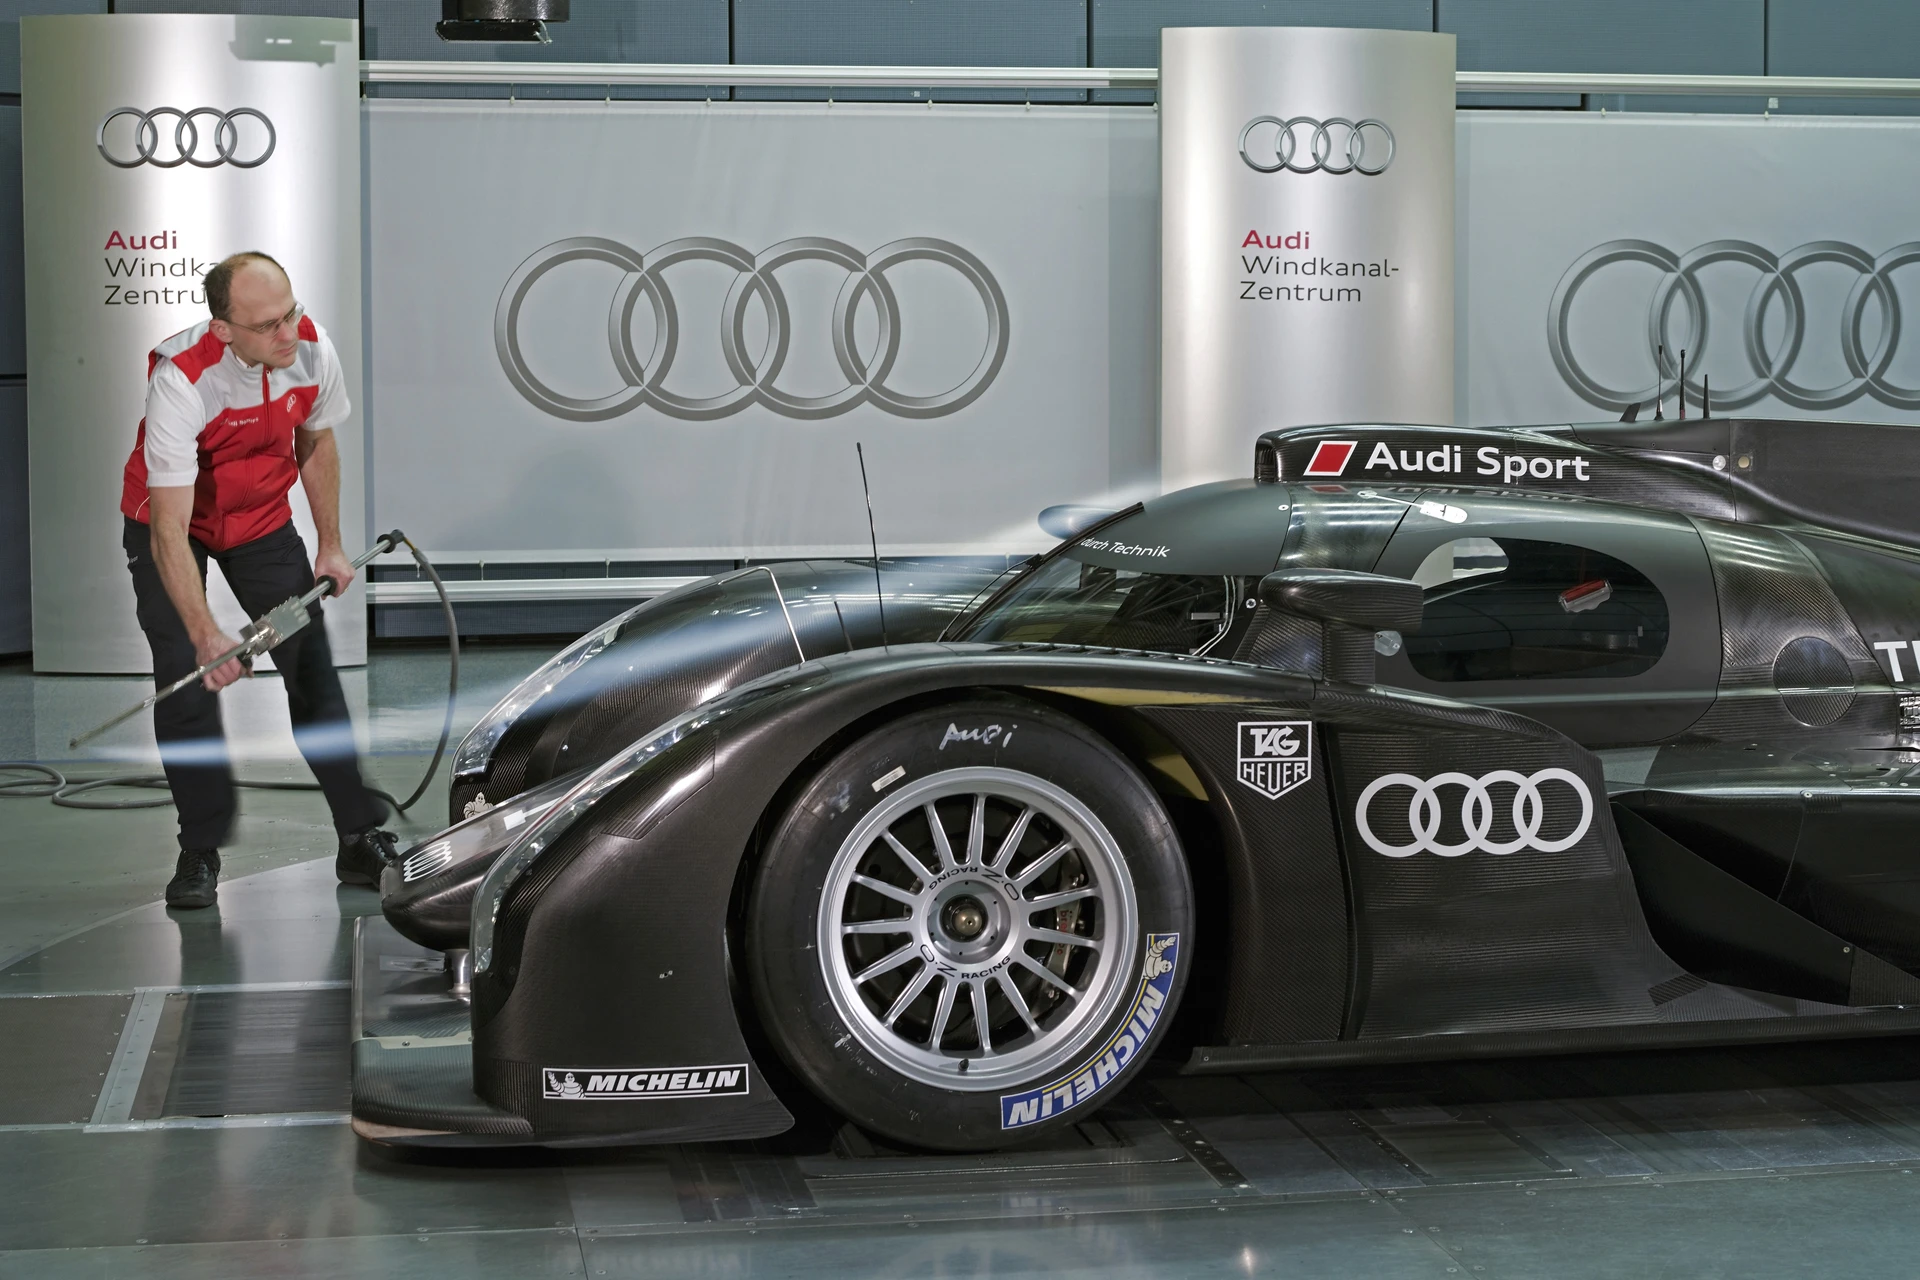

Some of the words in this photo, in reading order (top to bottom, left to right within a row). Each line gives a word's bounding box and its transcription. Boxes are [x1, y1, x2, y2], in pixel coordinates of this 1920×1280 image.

[104, 230, 177, 250] Audi
[1241, 229, 1310, 250] Audi
[1241, 255, 1399, 278] Windkanal-
[1239, 281, 1362, 302] Zentrum
[1364, 441, 1462, 473] Audi
[1476, 446, 1590, 484] Sport
[1109, 542, 1171, 558] Technik
[1873, 640, 1920, 683] T
[1250, 725, 1301, 757] TAG
[1243, 762, 1306, 794] HEUER
[929, 866, 979, 891] RACING
[960, 955, 1011, 979] RACING
[1007, 983, 1165, 1126] MICHELIN
[586, 1069, 741, 1092] MICHELIN
